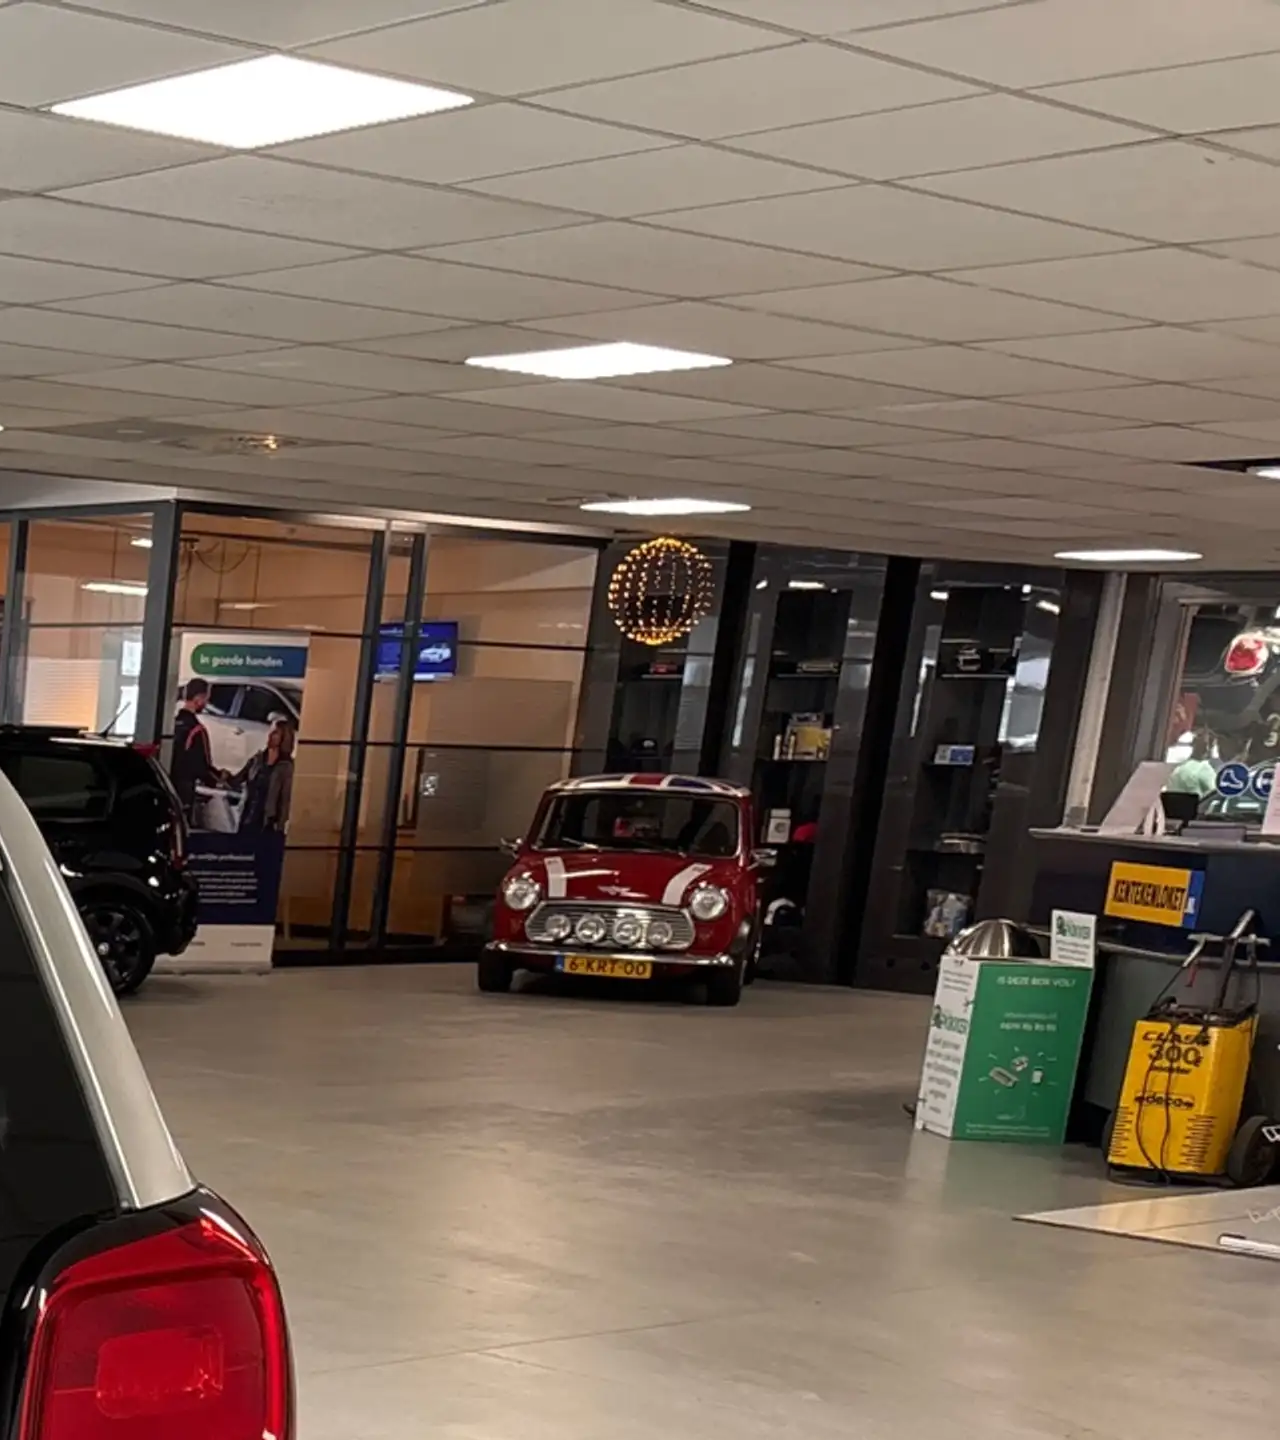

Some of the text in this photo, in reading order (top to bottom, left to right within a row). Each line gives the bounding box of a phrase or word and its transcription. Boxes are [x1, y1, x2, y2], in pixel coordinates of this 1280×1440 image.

[212, 654, 243, 667] goede
[246, 655, 283, 667] handen
[1114, 879, 1186, 911] KENTEKENLOKET
